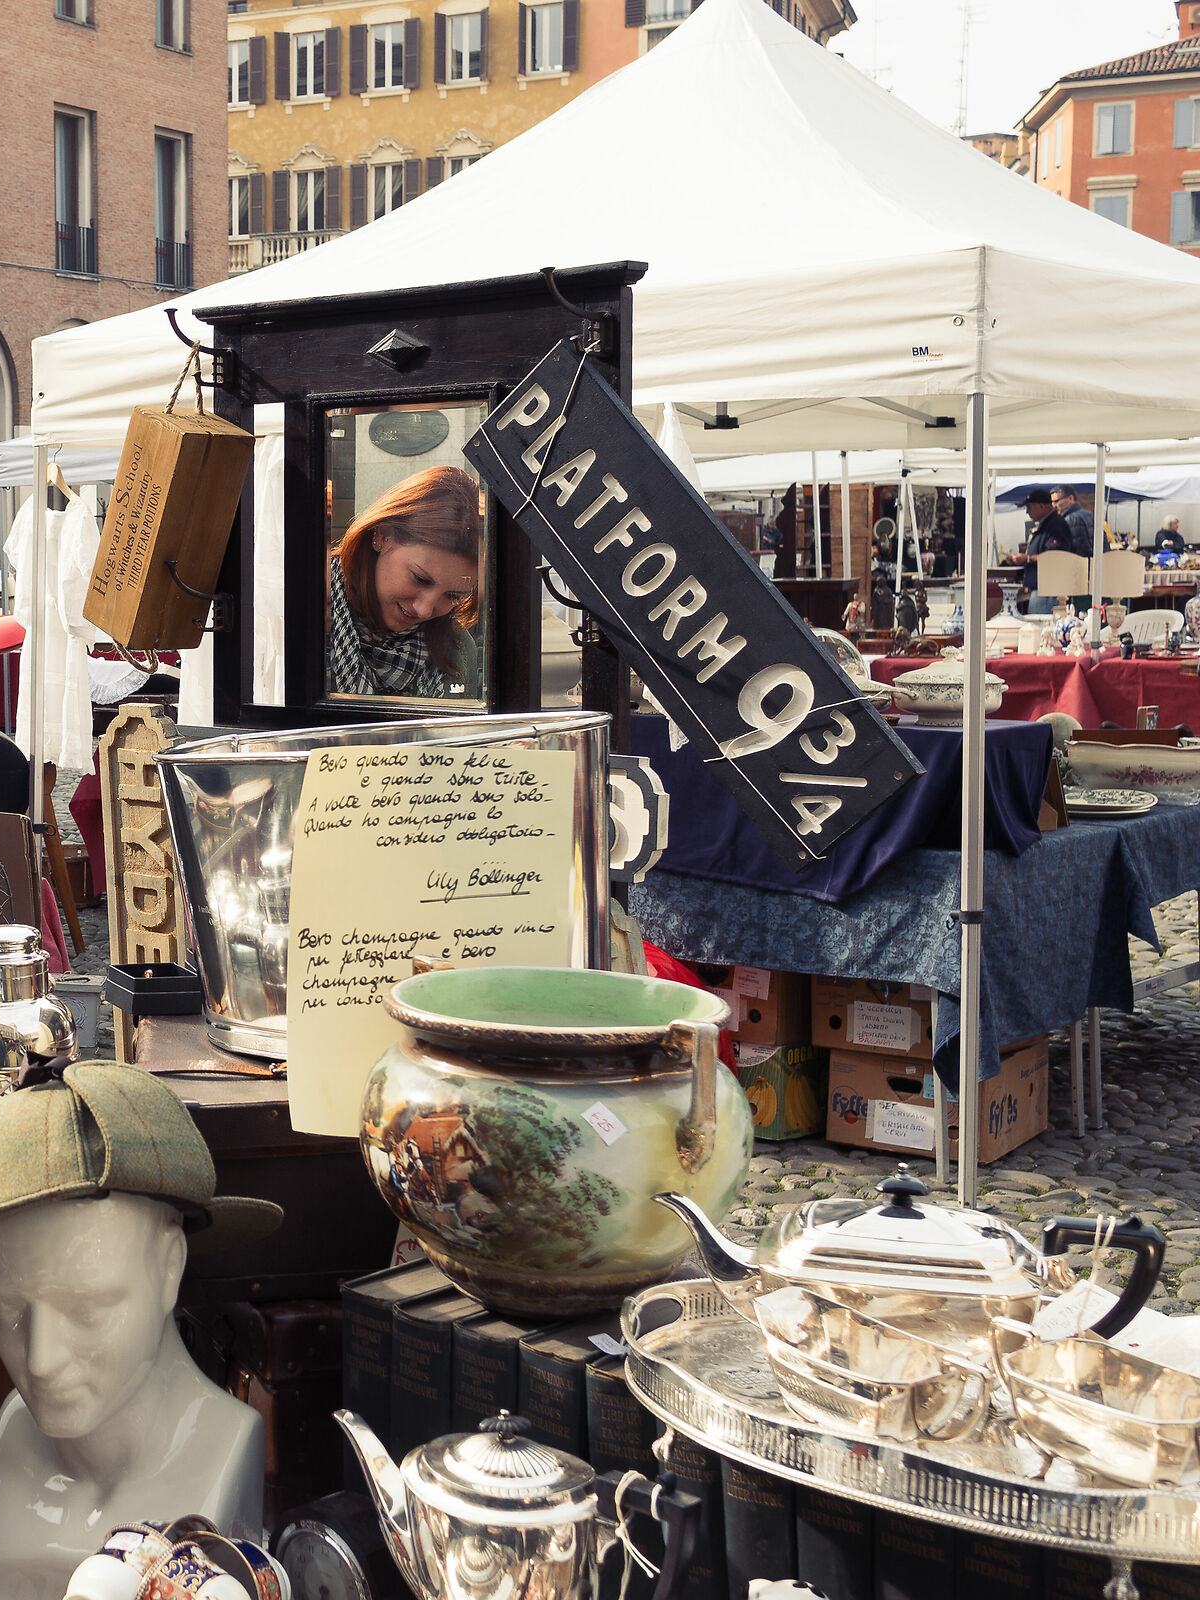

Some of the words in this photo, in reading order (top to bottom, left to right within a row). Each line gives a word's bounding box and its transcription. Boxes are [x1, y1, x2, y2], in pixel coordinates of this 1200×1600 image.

[911, 346, 929, 357] BM
[131, 471, 153, 519] Wizardry
[143, 483, 162, 528] POTIONS
[92, 512, 125, 597] Hogwarts
[115, 443, 143, 509] School
[128, 523, 139, 535] &
[117, 535, 136, 574] Witches
[136, 529, 151, 558] YEAR
[115, 573, 125, 592] of
[127, 554, 142, 590] THIRD
[496, 383, 747, 683] PLATFORM
[718, 663, 815, 760] 9
[319, 753, 348, 773] Bevo
[356, 751, 409, 775] quando
[418, 752, 454, 767] sono
[463, 752, 513, 779] felice
[360, 775, 371, 788] e
[381, 774, 433, 794] quando
[446, 773, 484, 787] sono
[308, 797, 318, 814] A
[370, 791, 401, 809] bevo
[409, 794, 461, 813] quando
[470, 790, 505, 804] sono
[304, 817, 352, 837] Quando
[361, 813, 380, 828] ho
[487, 806, 503, 820] lo
[117, 748, 173, 964] HYDE
[298, 928, 332, 949] Bevo
[453, 925, 503, 946] quando
[306, 955, 330, 973] per
[442, 947, 451, 959] e
[461, 946, 496, 959] bevo
[302, 996, 326, 1013] per
